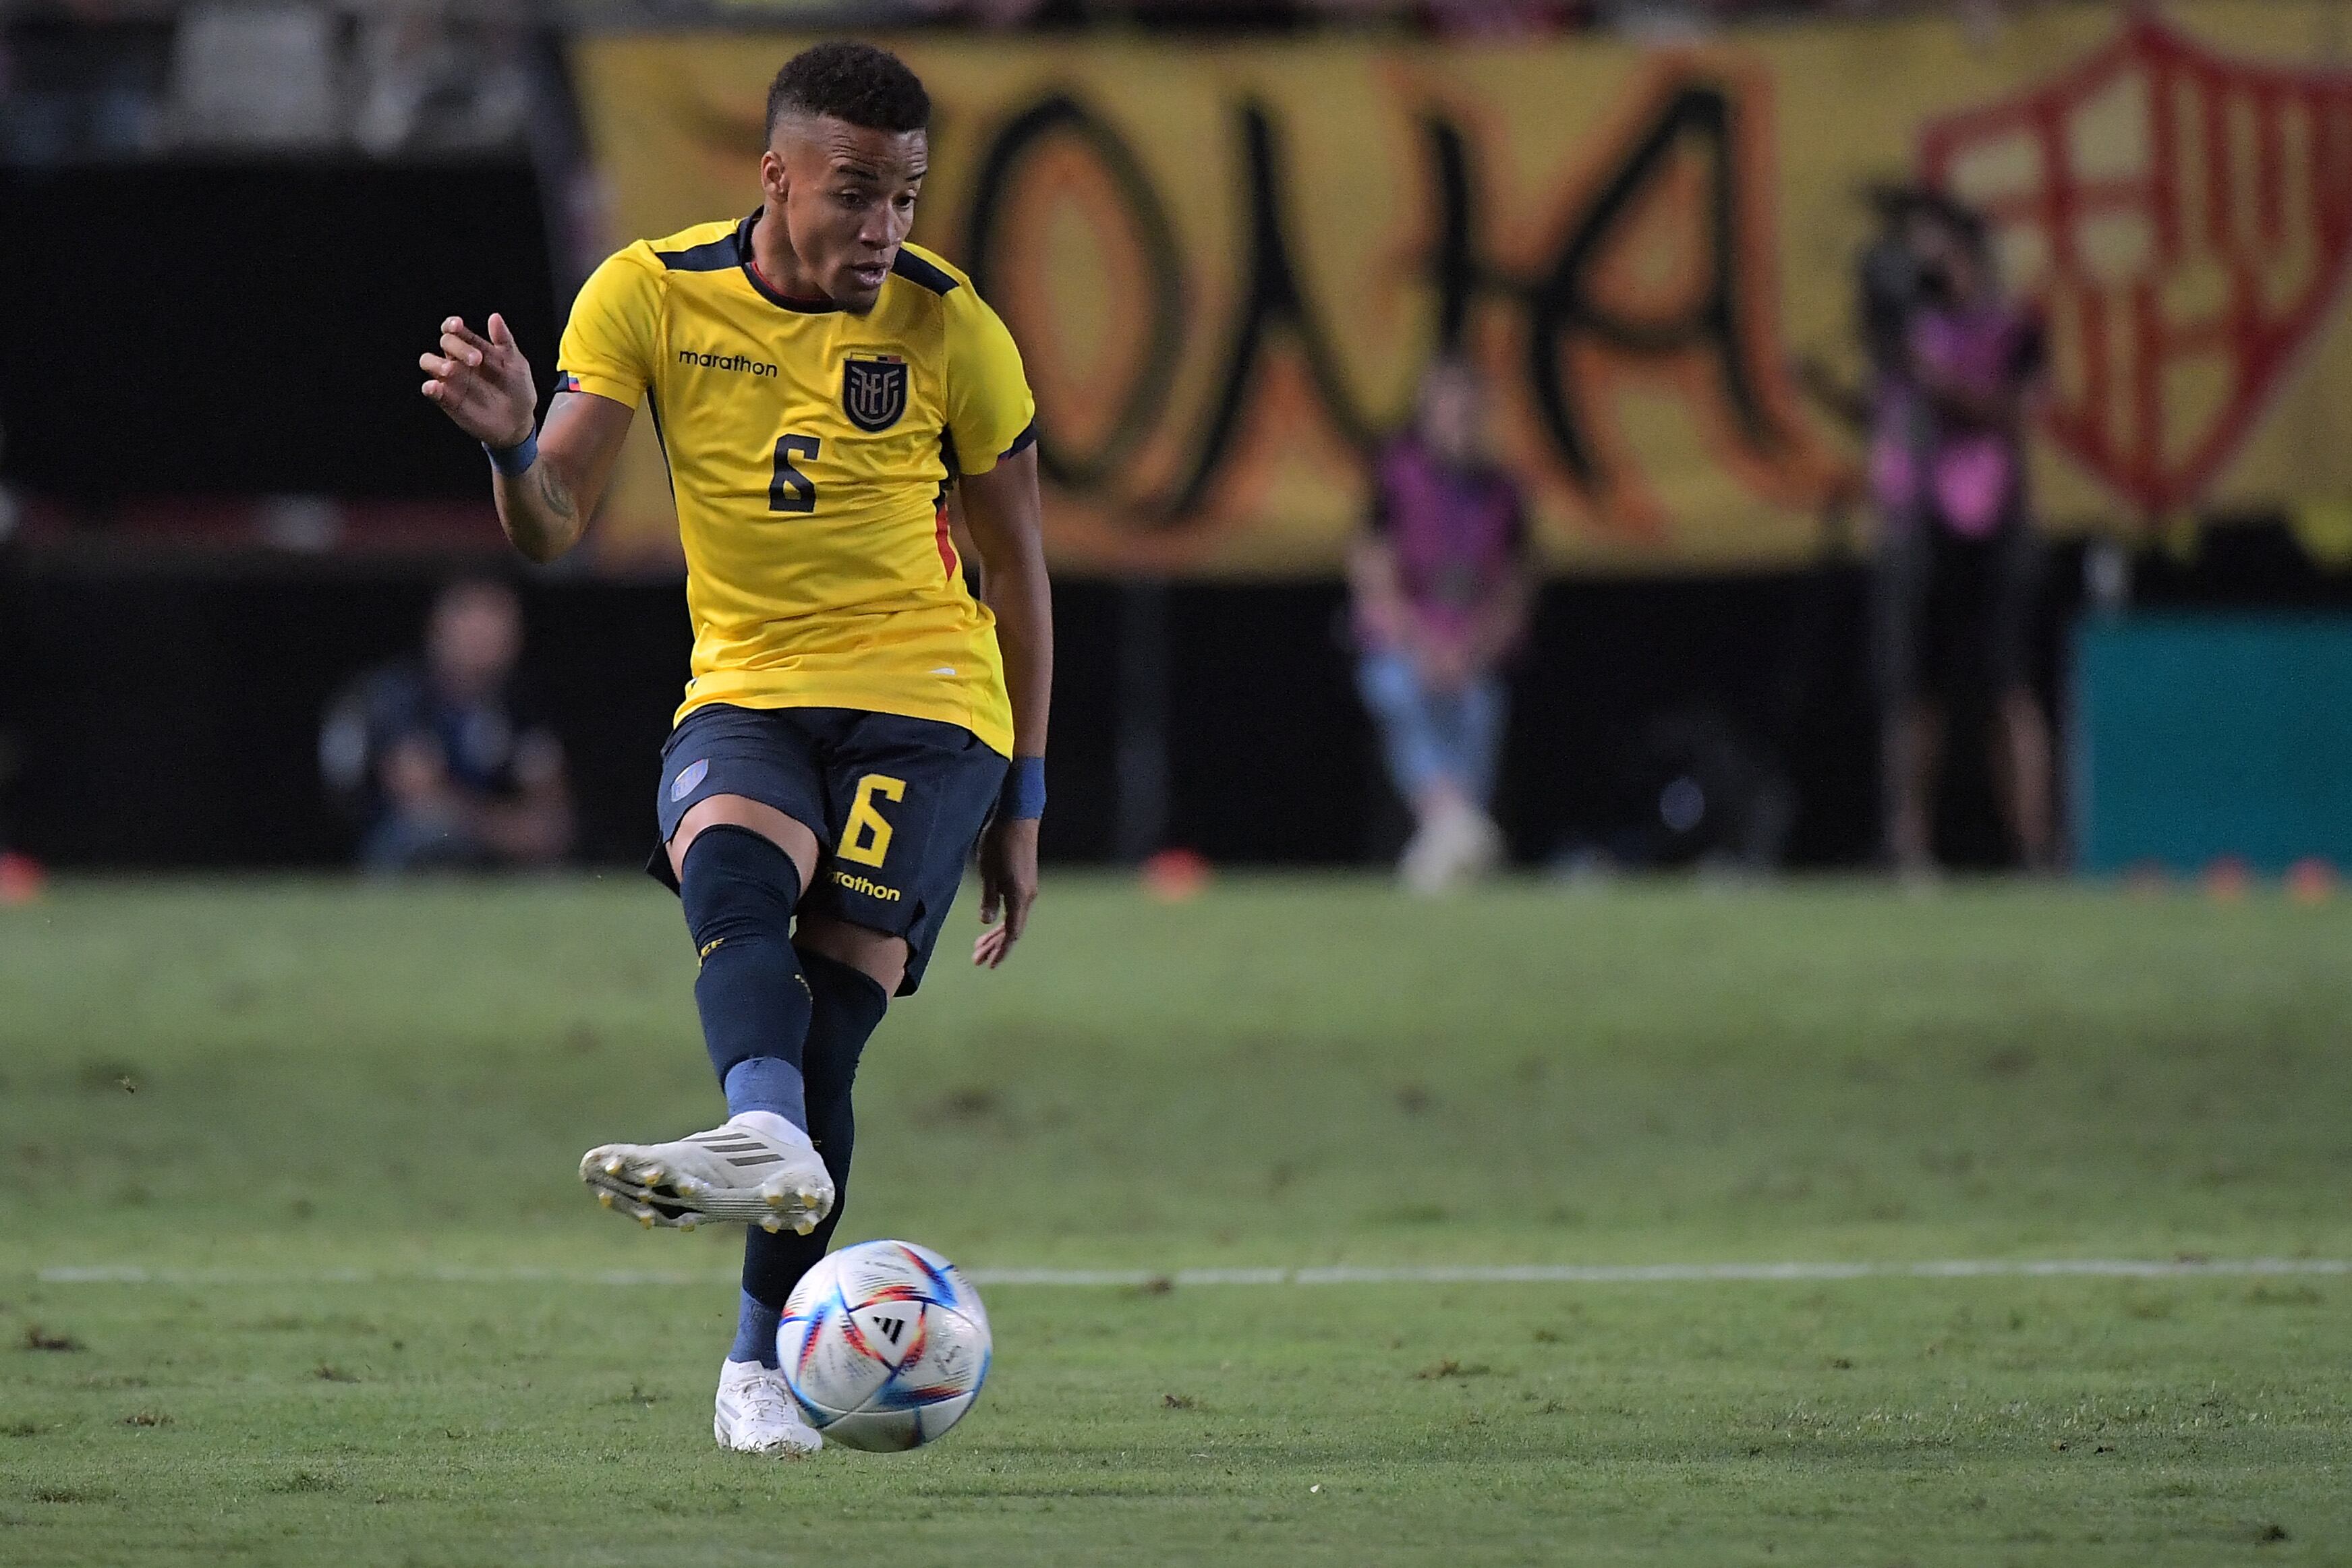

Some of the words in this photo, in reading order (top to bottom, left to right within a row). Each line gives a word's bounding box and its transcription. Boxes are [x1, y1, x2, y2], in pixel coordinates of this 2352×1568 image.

[679, 350, 778, 378] marathon
[769, 433, 821, 513] 6
[836, 774, 907, 869] 6
[832, 871, 901, 902] rathon
